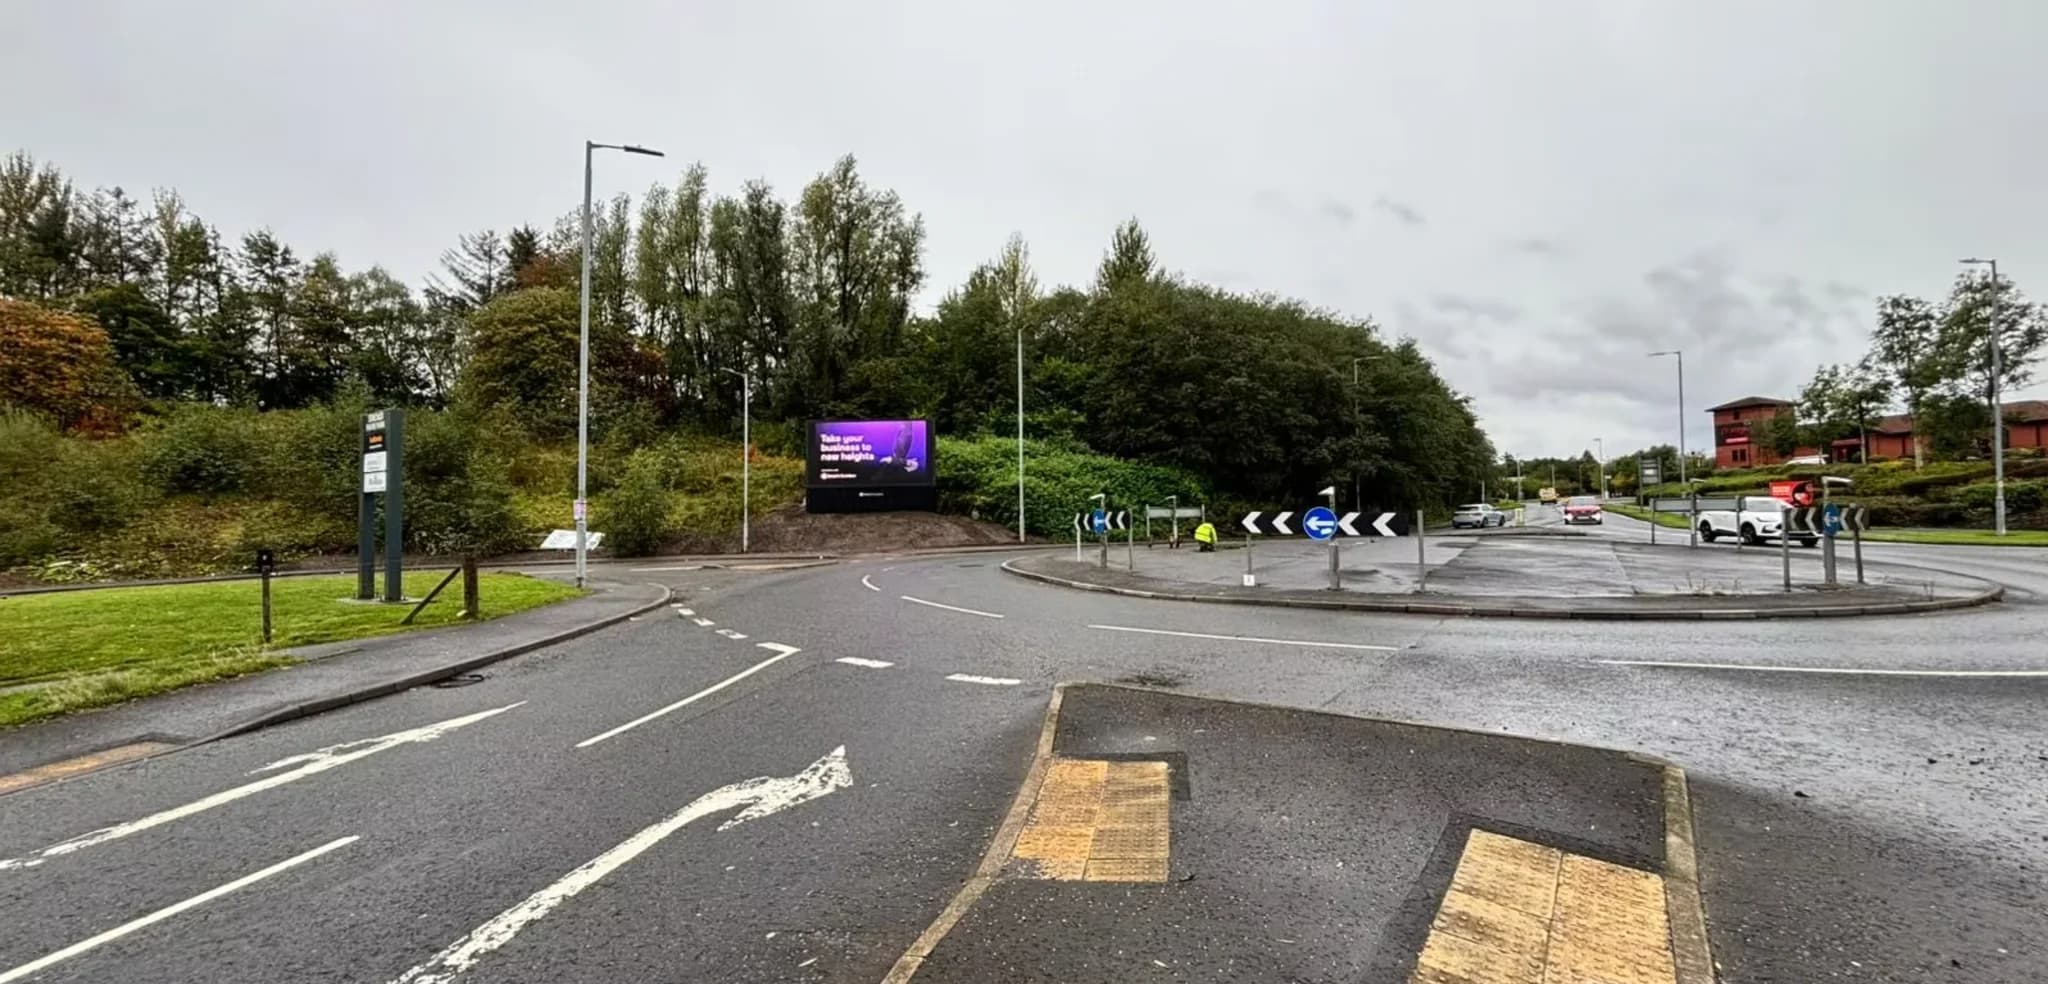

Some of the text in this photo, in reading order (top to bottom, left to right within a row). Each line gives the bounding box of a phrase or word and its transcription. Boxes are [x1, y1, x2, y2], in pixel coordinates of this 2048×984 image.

[820, 434, 864, 444] Take your
[820, 443, 872, 452] business to
[840, 452, 874, 462] heights
